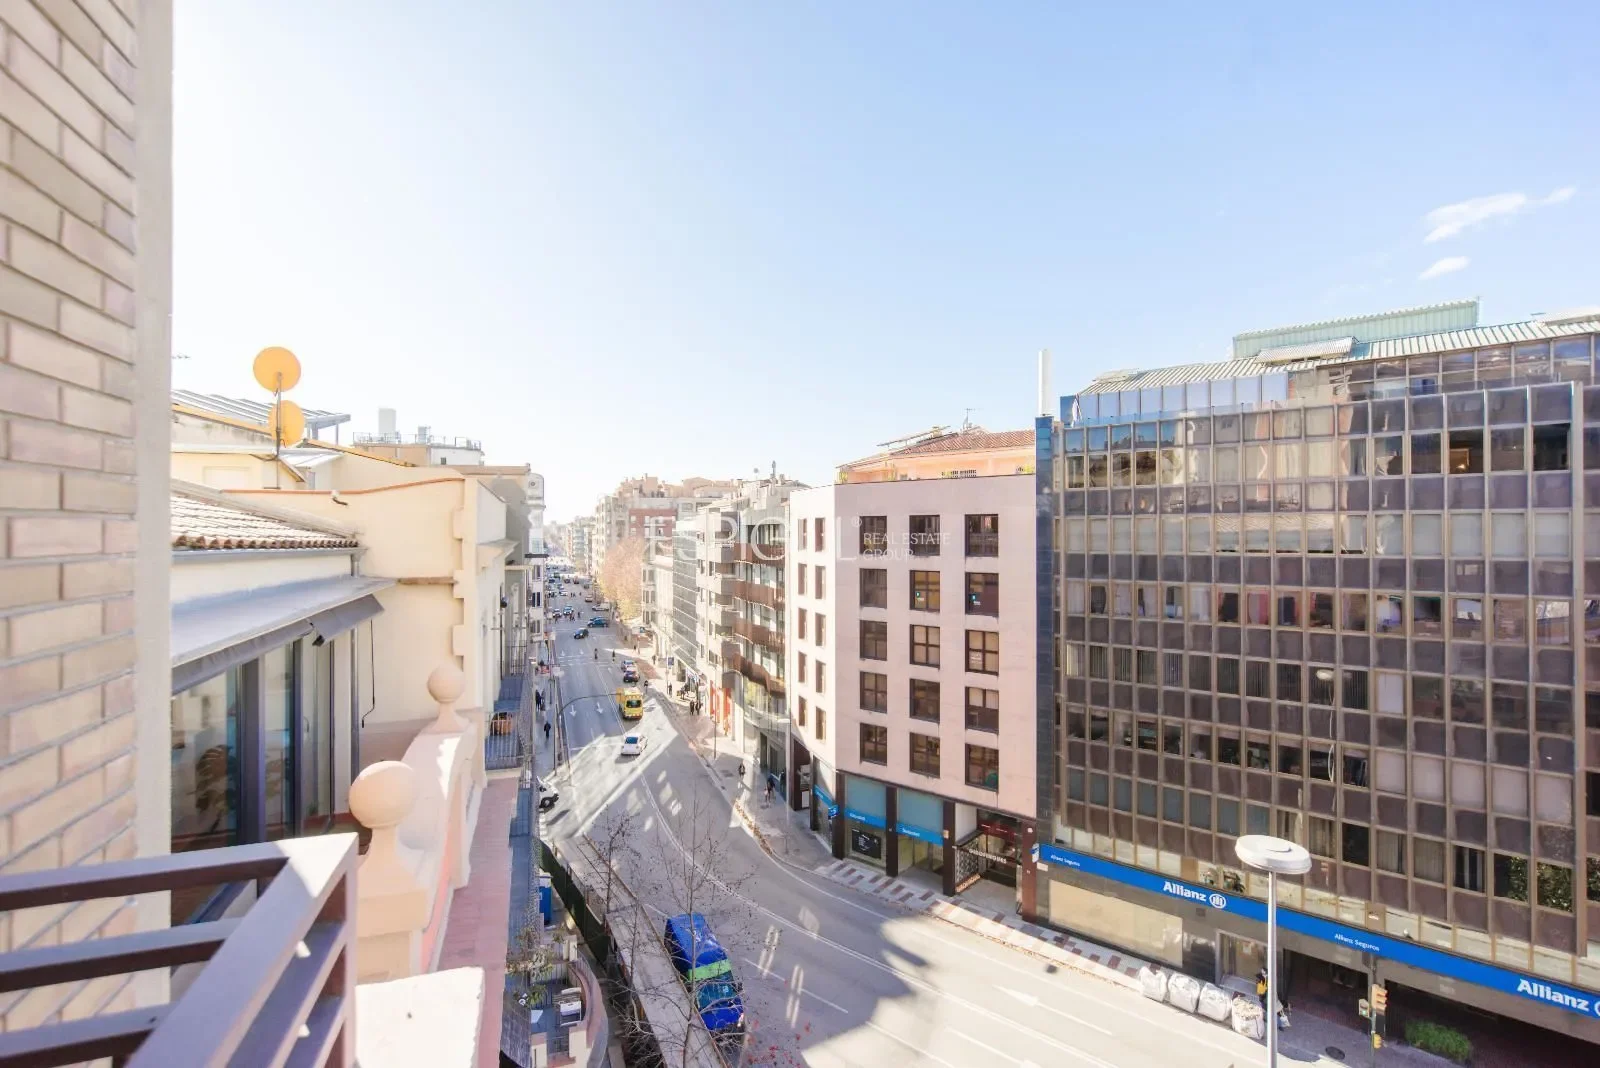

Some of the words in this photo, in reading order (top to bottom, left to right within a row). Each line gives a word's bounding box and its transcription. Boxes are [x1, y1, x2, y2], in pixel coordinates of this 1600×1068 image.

[1163, 881, 1207, 902] Allianz
[1334, 933, 1354, 945] Allianz
[1355, 939, 1380, 952] Seguros
[1517, 978, 1590, 1012] Allianz
